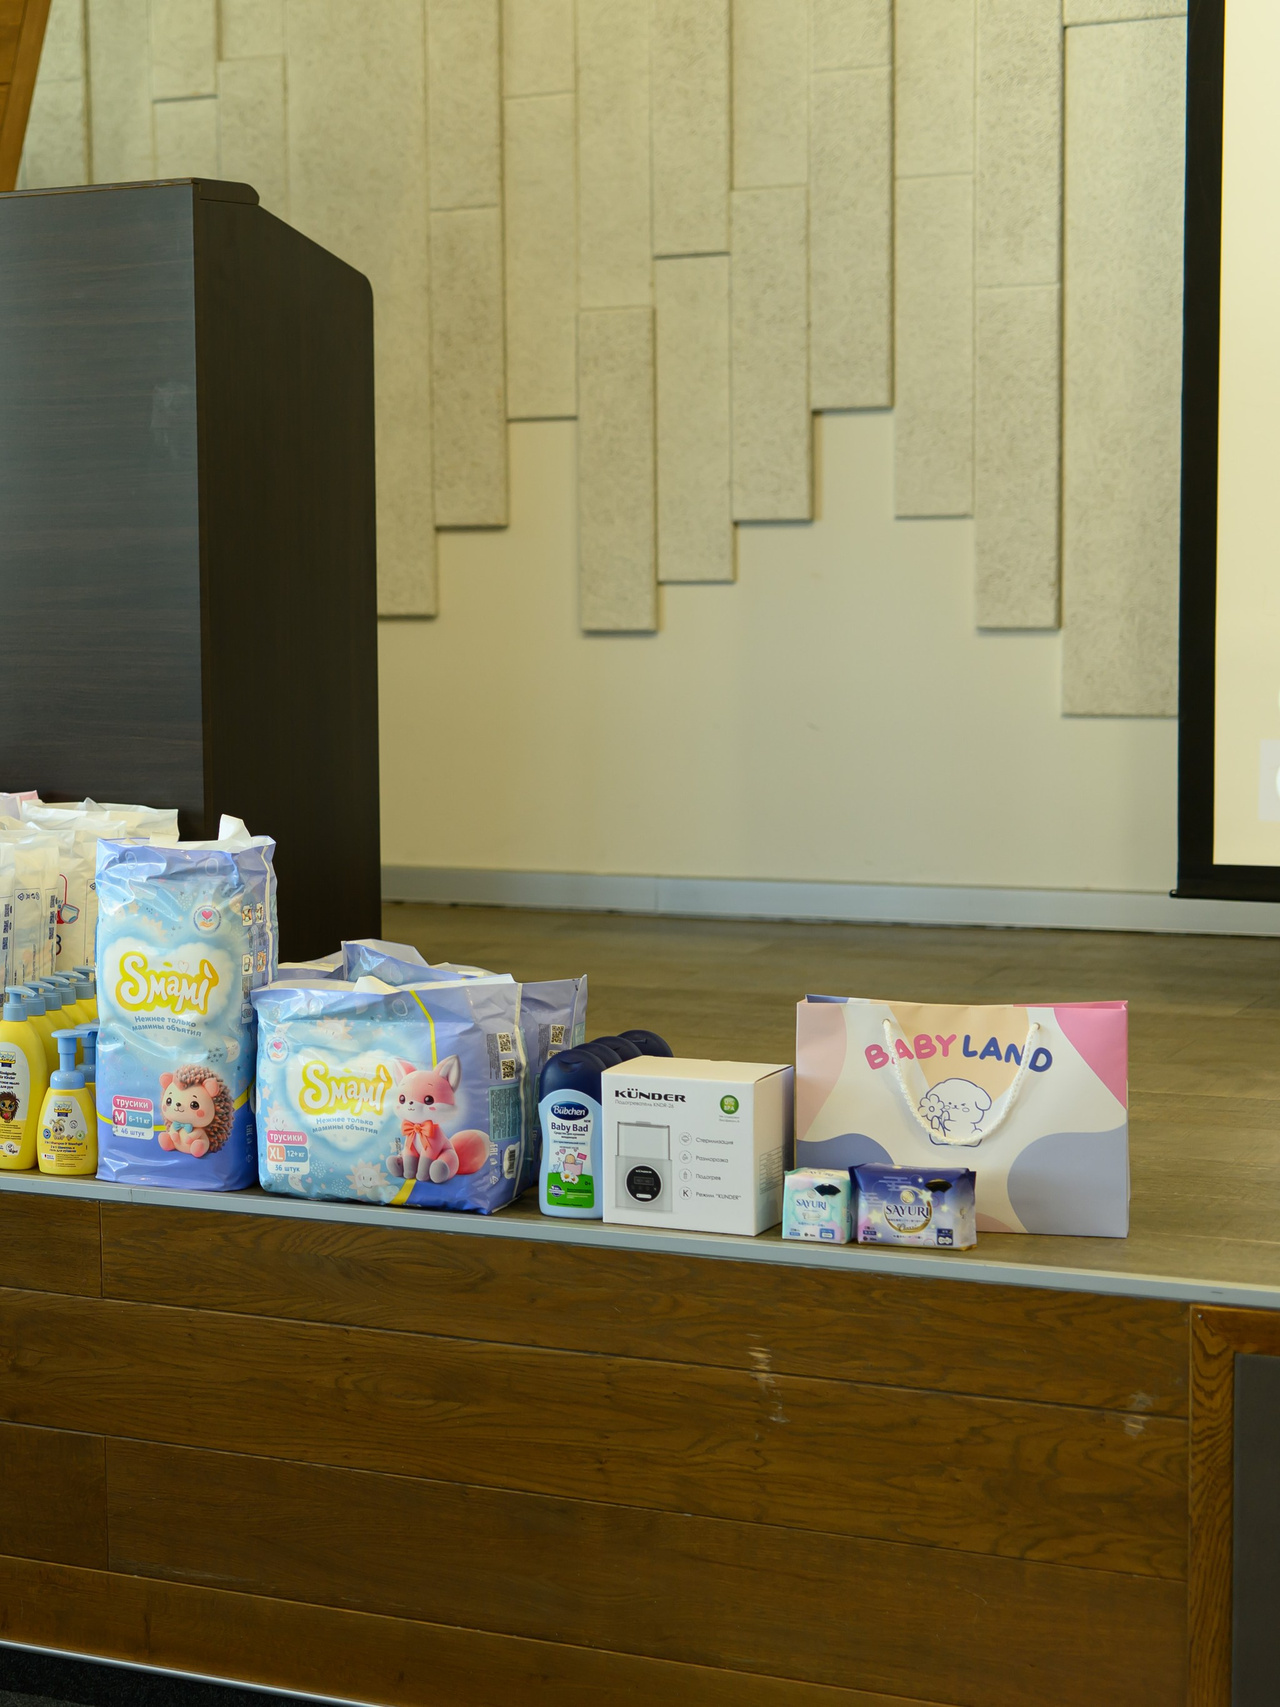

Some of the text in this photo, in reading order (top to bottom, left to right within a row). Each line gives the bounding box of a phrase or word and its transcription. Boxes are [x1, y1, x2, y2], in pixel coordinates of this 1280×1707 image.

[134, 1015, 197, 1028] Нежнее только
[132, 1023, 202, 1037] мамины объятия
[864, 1034, 1053, 1072] BABY LAND
[615, 1088, 686, 1103] KÜNDER
[115, 1098, 149, 1109] трусики
[553, 1104, 586, 1116] Bübchen
[115, 1110, 125, 1124] M
[128, 1115, 143, 1124] 6-11
[316, 1117, 374, 1126] Нежнее только
[121, 1127, 129, 1135] 46
[312, 1124, 379, 1135] мамины объятия
[551, 1122, 589, 1136] Baby Bad
[269, 1133, 303, 1143] трусики
[269, 1147, 284, 1160] XL
[286, 1150, 298, 1158] 12+
[796, 1199, 827, 1211] SAYURI
[885, 1204, 930, 1218] SAYURI
